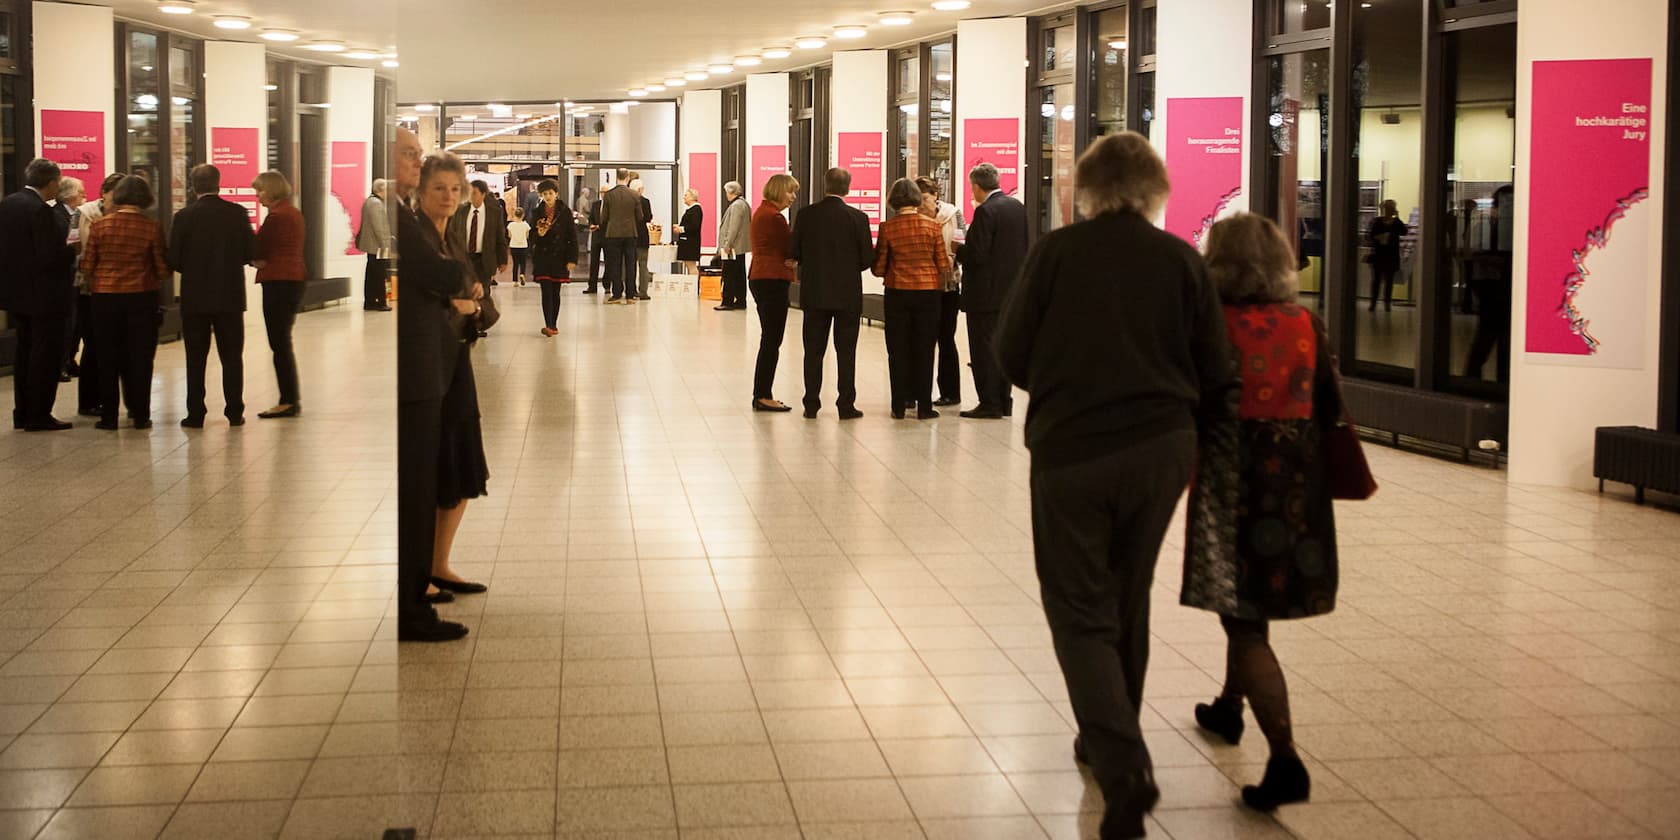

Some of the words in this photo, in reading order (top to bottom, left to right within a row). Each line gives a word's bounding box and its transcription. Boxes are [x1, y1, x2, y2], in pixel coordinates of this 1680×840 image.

[1622, 103, 1647, 113] Eine
[1575, 116, 1647, 128] hochkarätige
[1224, 127, 1240, 135] Drei
[1623, 129, 1646, 141] Jury
[1187, 137, 1240, 145] herausragende
